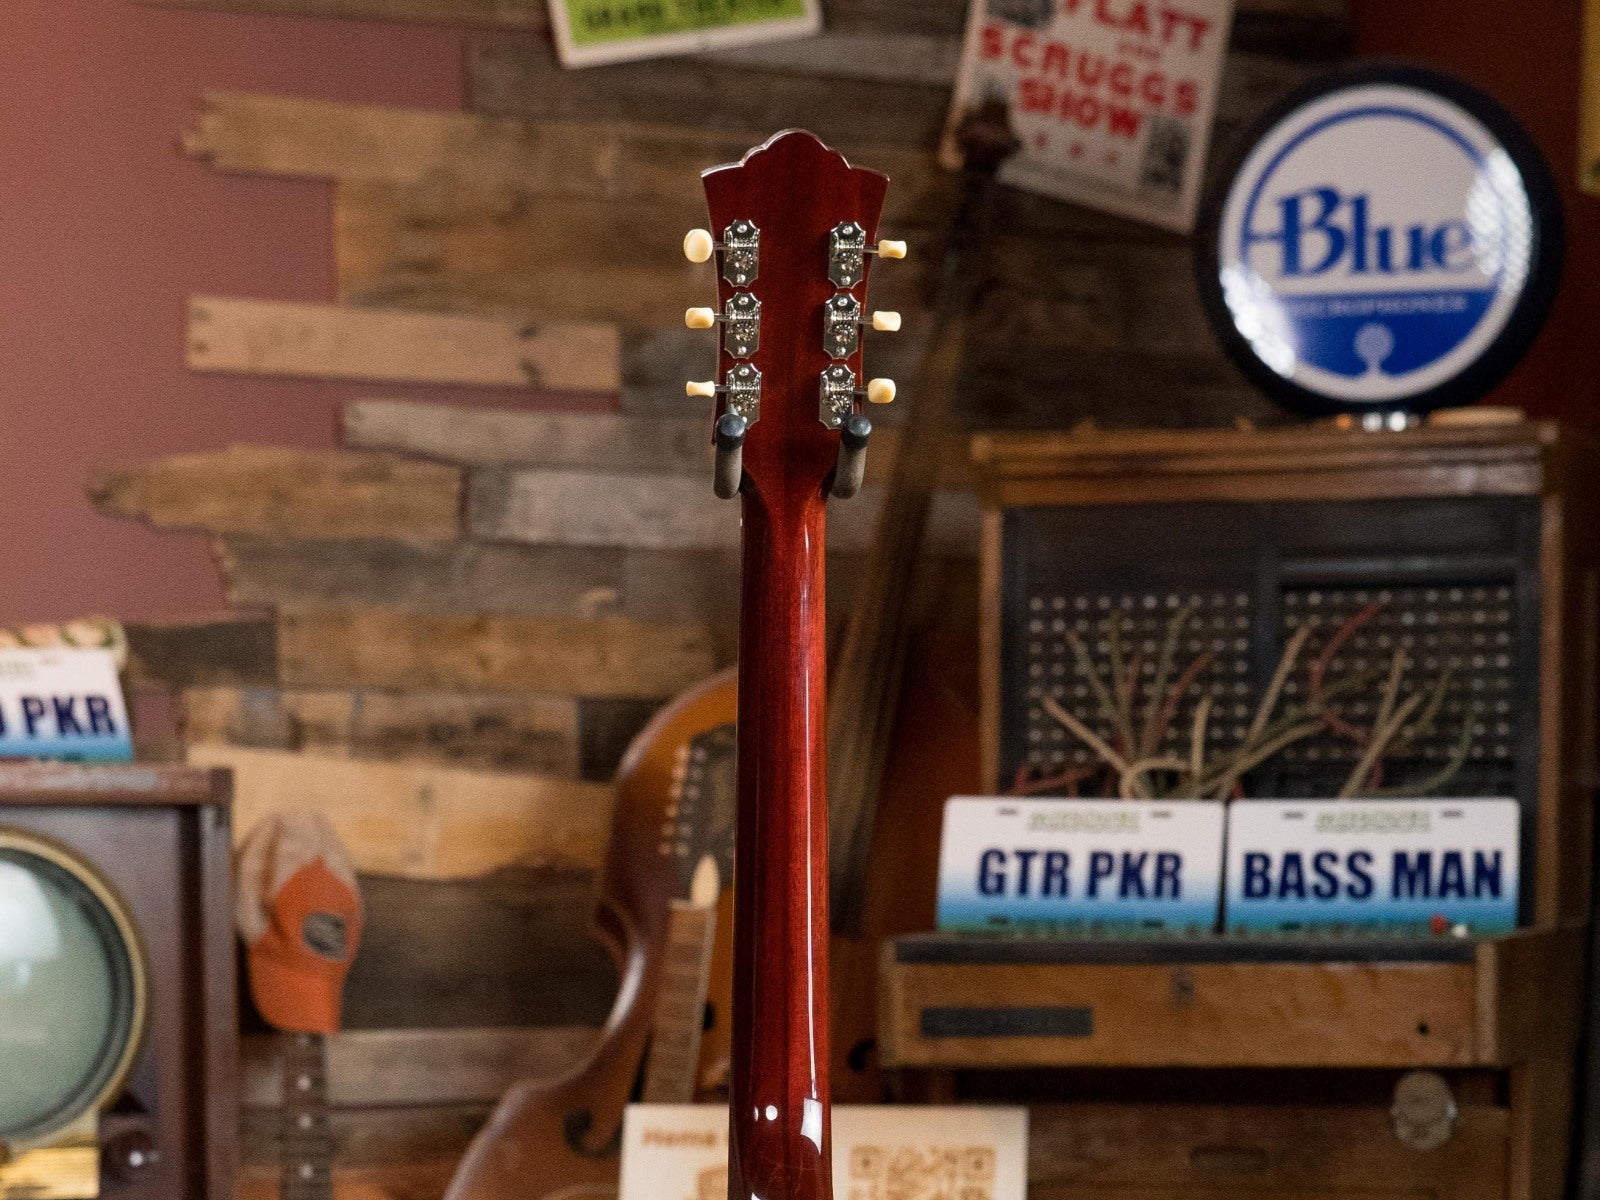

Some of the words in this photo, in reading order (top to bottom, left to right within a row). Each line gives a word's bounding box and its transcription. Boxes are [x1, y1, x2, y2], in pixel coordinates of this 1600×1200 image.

[980, 26, 1199, 117] SCRUGGS
[1019, 77, 1142, 140] SHOW
[1277, 184, 1480, 277] Blue
[21, 696, 116, 737] PKR
[977, 850, 1070, 899] GTR
[1086, 850, 1183, 899] PKR
[1244, 851, 1374, 900] BASS
[1391, 850, 1503, 898] MAN
